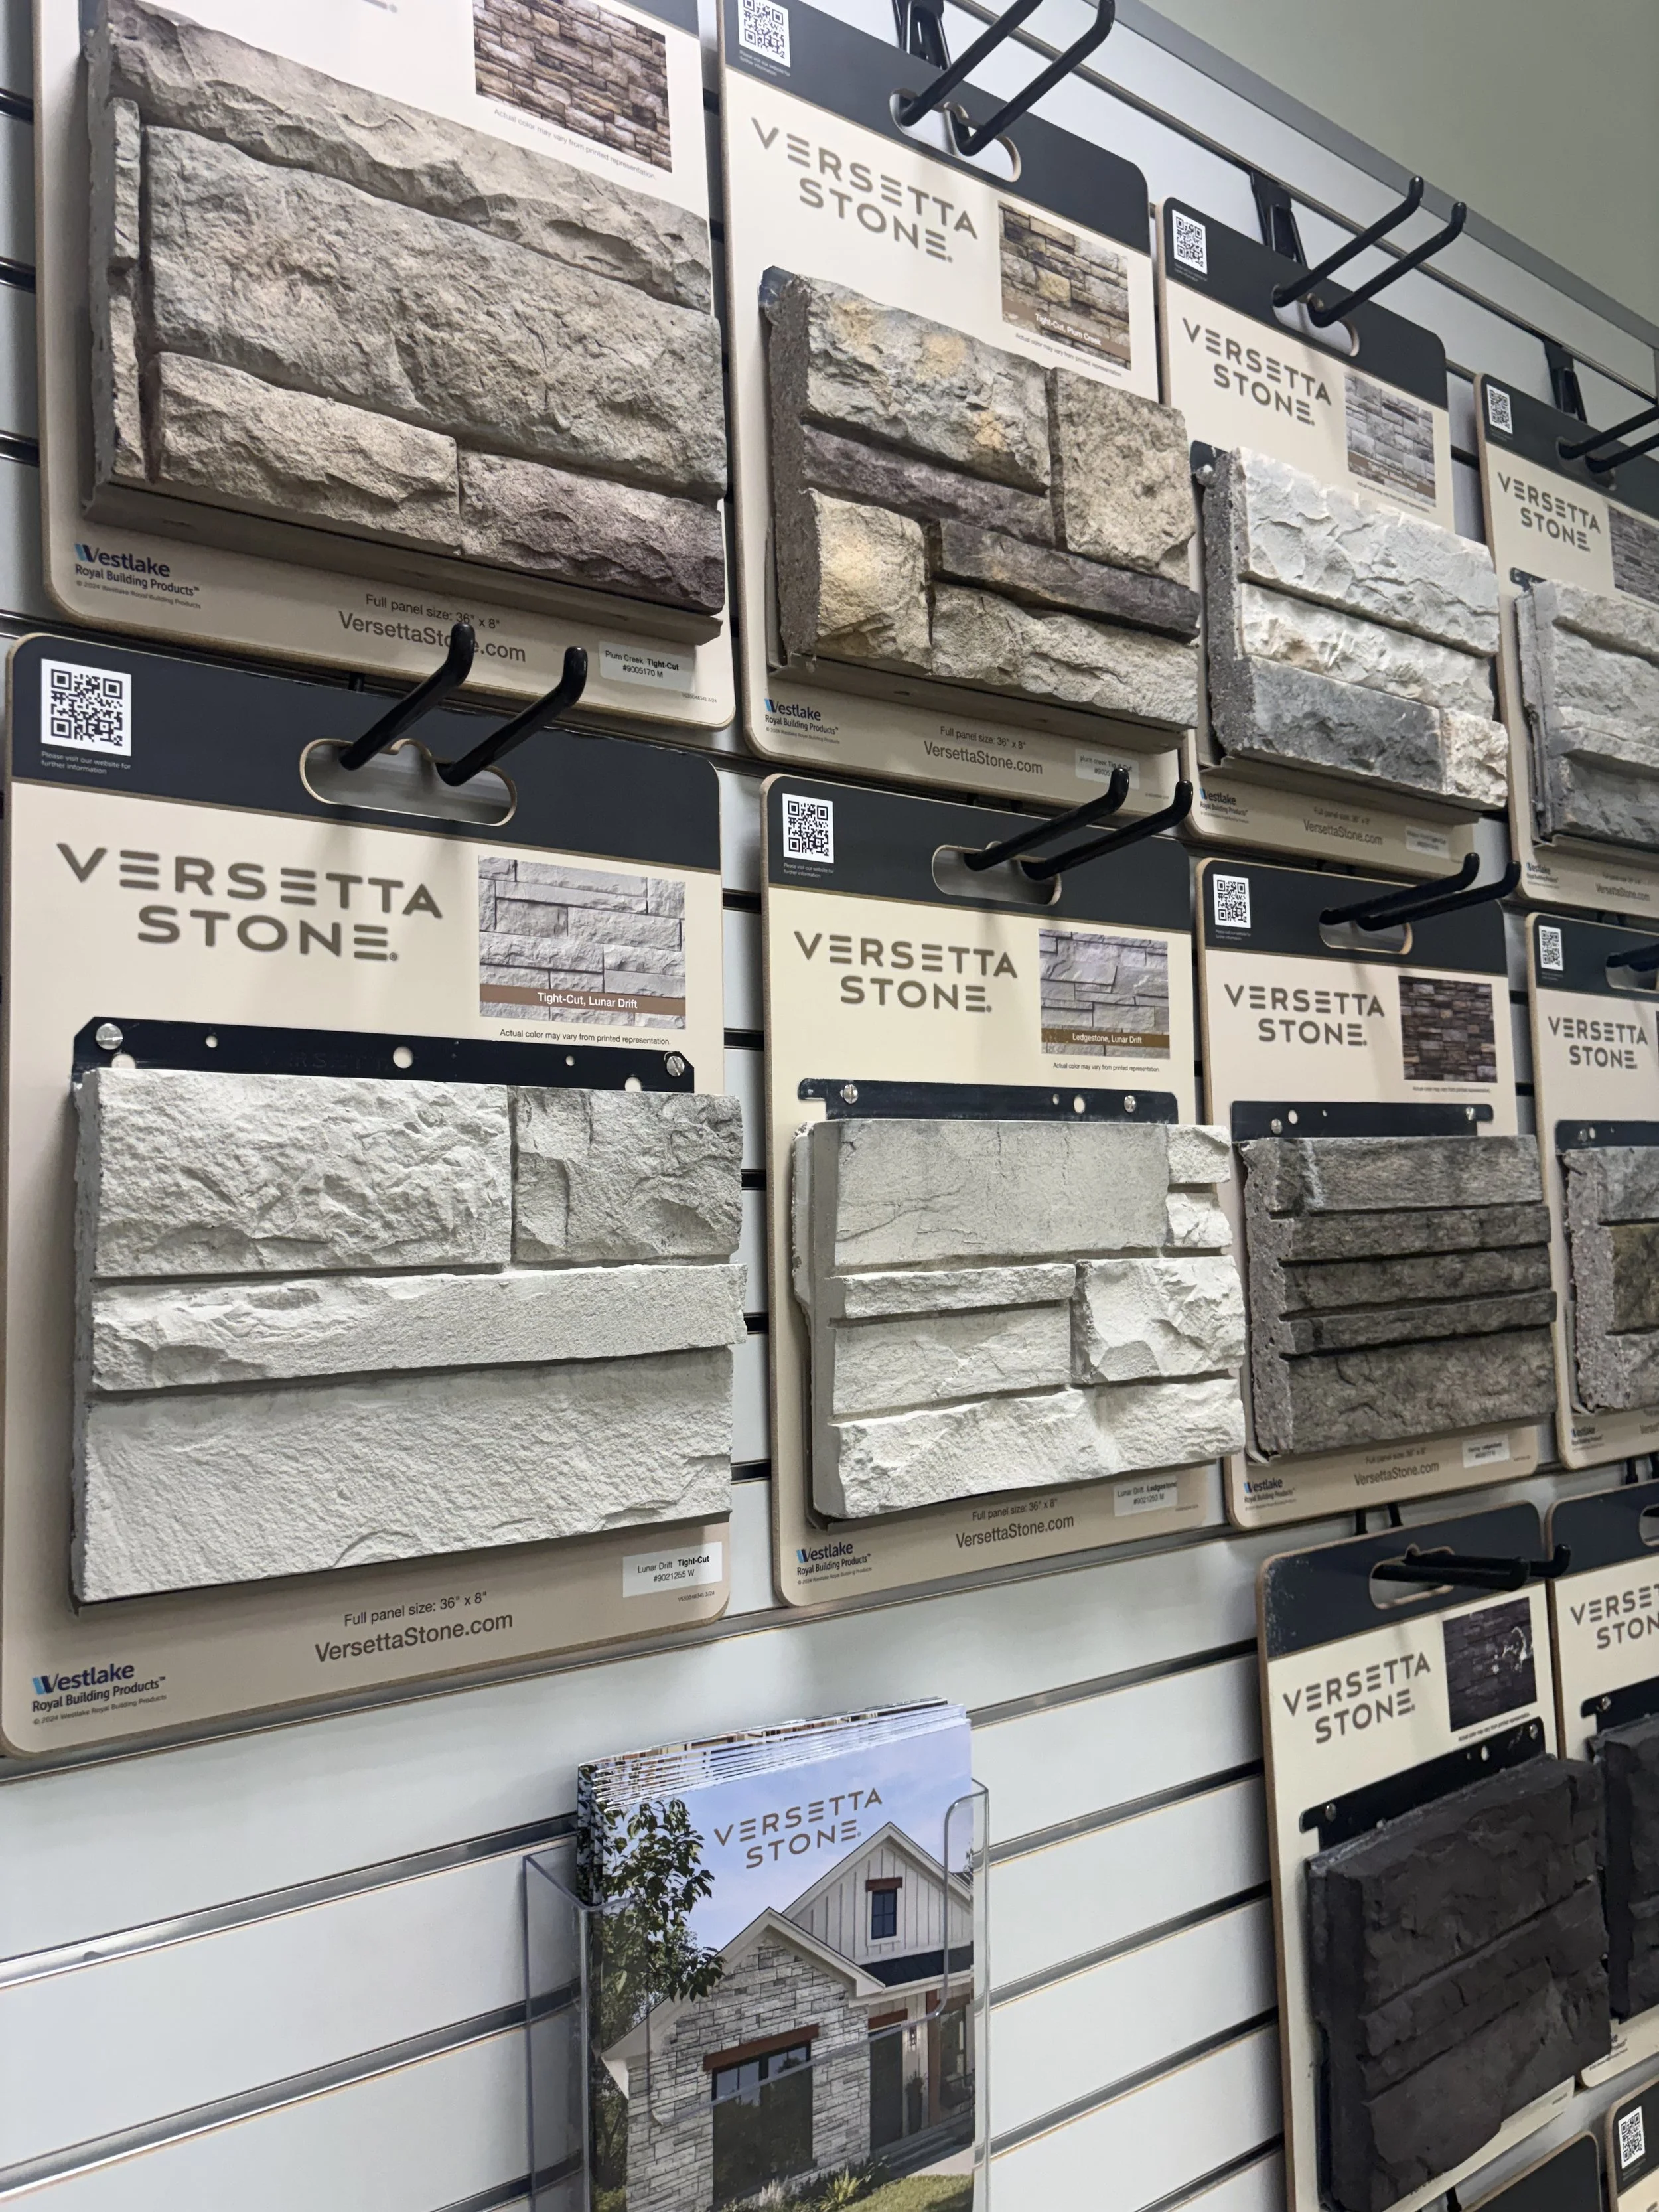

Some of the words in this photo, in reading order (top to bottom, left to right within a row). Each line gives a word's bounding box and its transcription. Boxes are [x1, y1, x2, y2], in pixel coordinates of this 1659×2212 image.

[494, 108, 516, 123] Actual
[518, 118, 536, 130] color
[537, 127, 551, 138] may
[553, 133, 567, 144] vary
[569, 138, 585, 151] from
[585, 147, 609, 161] printed
[751, 117, 979, 240] VERSETTA
[1035, 313, 1066, 332] Tight-Cut,
[1067, 326, 1083, 339] Plum
[1084, 333, 1102, 346] Creek
[1182, 317, 1332, 406] VERSETTA
[1498, 471, 1601, 534] VERSETTA
[74, 544, 170, 577] Westlake
[75, 564, 104, 579] Royal
[106, 570, 148, 590] Building
[366, 594, 387, 609] Full
[391, 600, 423, 615] panel
[427, 607, 453, 621] size:
[478, 619, 486, 627] x
[338, 610, 526, 662] VersettaStoe.com
[605, 650, 622, 660] Plum
[624, 654, 644, 664] Creek
[647, 658, 680, 671] Tight-Cut
[764, 698, 821, 721] Westlake
[765, 715, 782, 725] Royal
[783, 718, 808, 731] Building
[940, 726, 954, 737] Full
[956, 730, 977, 740] panel
[978, 733, 995, 745] size:
[41, 751, 64, 761] Please
[94, 759, 120, 769] website
[41, 760, 66, 769] further
[67, 763, 107, 774] information
[924, 740, 1043, 774] VersettaStone.com
[1303, 818, 1383, 845] VersettaStone.com
[56, 842, 443, 919] VERSETTA
[794, 930, 1018, 979] VERSETTA
[538, 992, 586, 1006] Tight-Cut,
[589, 998, 616, 1008] Lunar
[618, 999, 638, 1009] Drift
[1224, 983, 1385, 1017] VERSETTA
[500, 1029, 524, 1038] Actual
[545, 1033, 561, 1041] may
[597, 1034, 620, 1044] printed
[622, 1036, 671, 1046] representation.
[1072, 1033, 1110, 1043] Ledgestone,
[1548, 1016, 1648, 1045] VERSETTA
[1354, 1462, 1439, 1486] VersettaStone.com
[972, 1511, 985, 1521] Full
[988, 1509, 1009, 1520] panel
[1011, 1505, 1027, 1514] size:
[956, 1516, 1074, 1548] VersettaStone.com
[637, 1564, 657, 1574] Lunar
[658, 1561, 673, 1570] Drift
[678, 1555, 709, 1568] Tight-Cut
[796, 1542, 853, 1563] Westlake
[653, 1570, 686, 1582] #9021255
[797, 1565, 814, 1576] Royal
[816, 1560, 840, 1573] Building
[344, 1611, 366, 1627] Full
[371, 1605, 405, 1624] panel
[409, 1602, 437, 1616] size:
[464, 1597, 472, 1606] x
[314, 1613, 513, 1662] VersettaStone.com
[32, 1663, 135, 1695] Westlake
[1283, 1651, 1431, 1717] VERSETTA
[32, 1696, 63, 1713] Royal
[66, 1688, 110, 1706] Building
[41, 1715, 59, 1724] 2024
[60, 1710, 90, 1720] Westlake
[91, 1705, 110, 1714] Royal
[111, 1700, 137, 1710] Building
[138, 1694, 167, 1705] Products
[714, 1787, 883, 1846] VERSETTA
